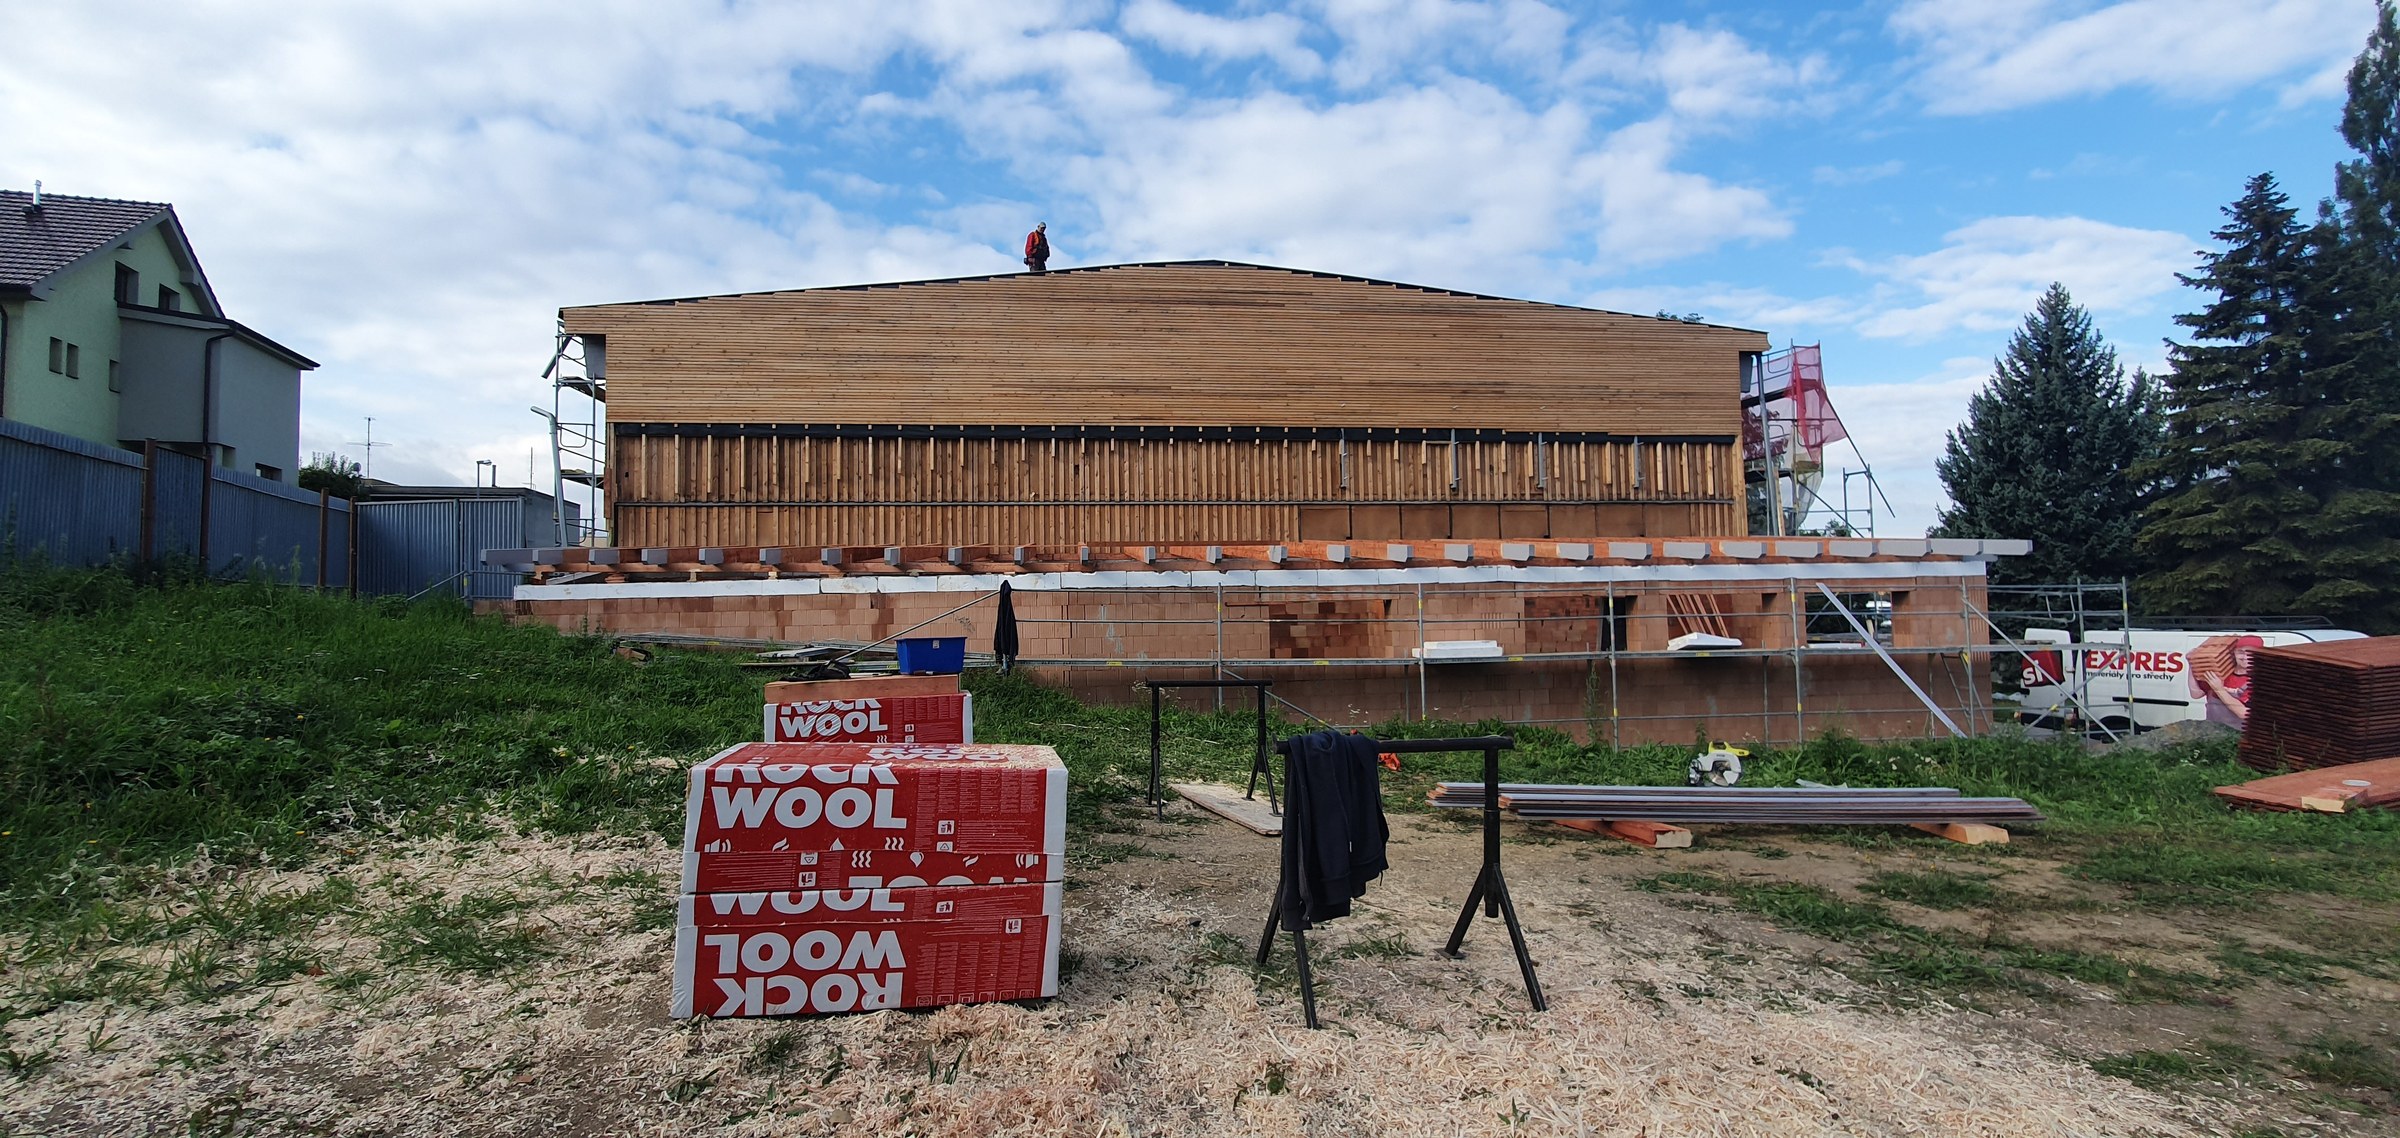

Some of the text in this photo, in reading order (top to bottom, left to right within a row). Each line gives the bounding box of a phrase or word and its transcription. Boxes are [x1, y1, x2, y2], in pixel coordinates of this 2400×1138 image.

[2086, 650, 2184, 673] EXPRES
[780, 709, 888, 738] WOOL
[714, 763, 900, 785] ROCK
[711, 786, 907, 829] WOOL
[704, 930, 906, 974] WOOL
[713, 972, 904, 1017] ROCK
